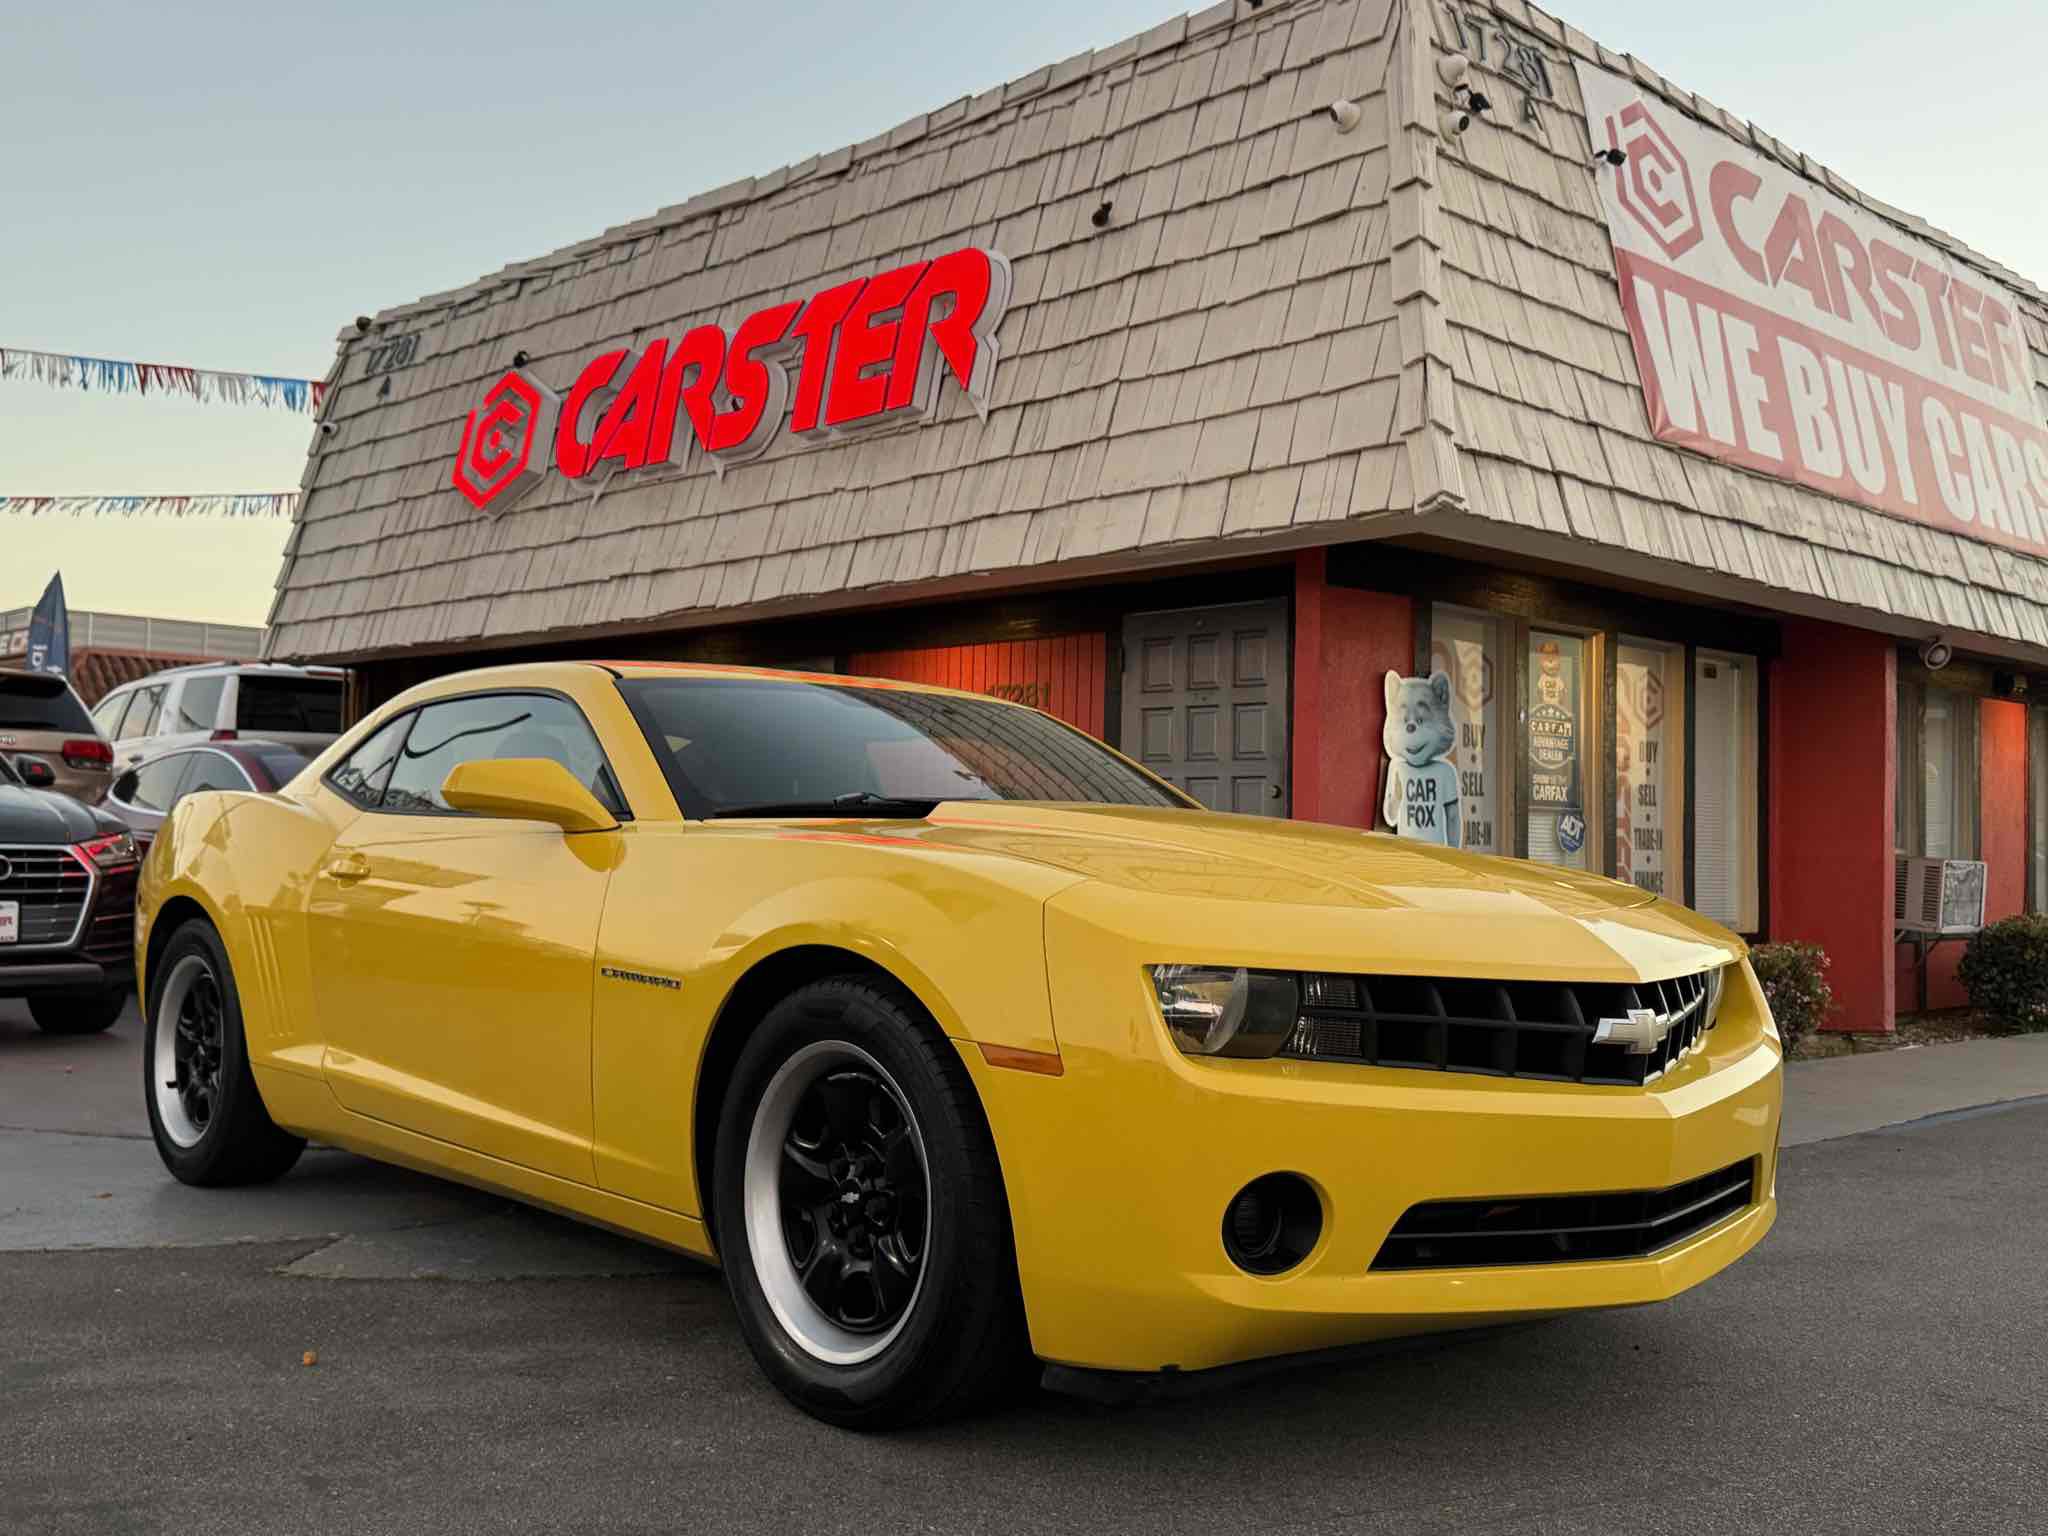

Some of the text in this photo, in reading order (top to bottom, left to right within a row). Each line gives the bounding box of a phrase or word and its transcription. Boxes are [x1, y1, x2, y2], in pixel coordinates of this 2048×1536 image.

[1709, 160, 2022, 394] CARSTER
[556, 247, 990, 479] CARSTER
[1632, 274, 1784, 461] WE
[1777, 335, 1918, 505] BUY
[1462, 722, 1486, 750] BUY
[1638, 740, 1659, 764] BUY
[1406, 778, 1437, 802] CAR
[1462, 770, 1485, 797] SELL
[1532, 784, 1569, 801] CARFAX
[1638, 784, 1657, 808] SELL
[1406, 804, 1437, 828] FOX
[1560, 815, 1584, 839] ADT
[1633, 828, 1664, 851] TRADE-IN
